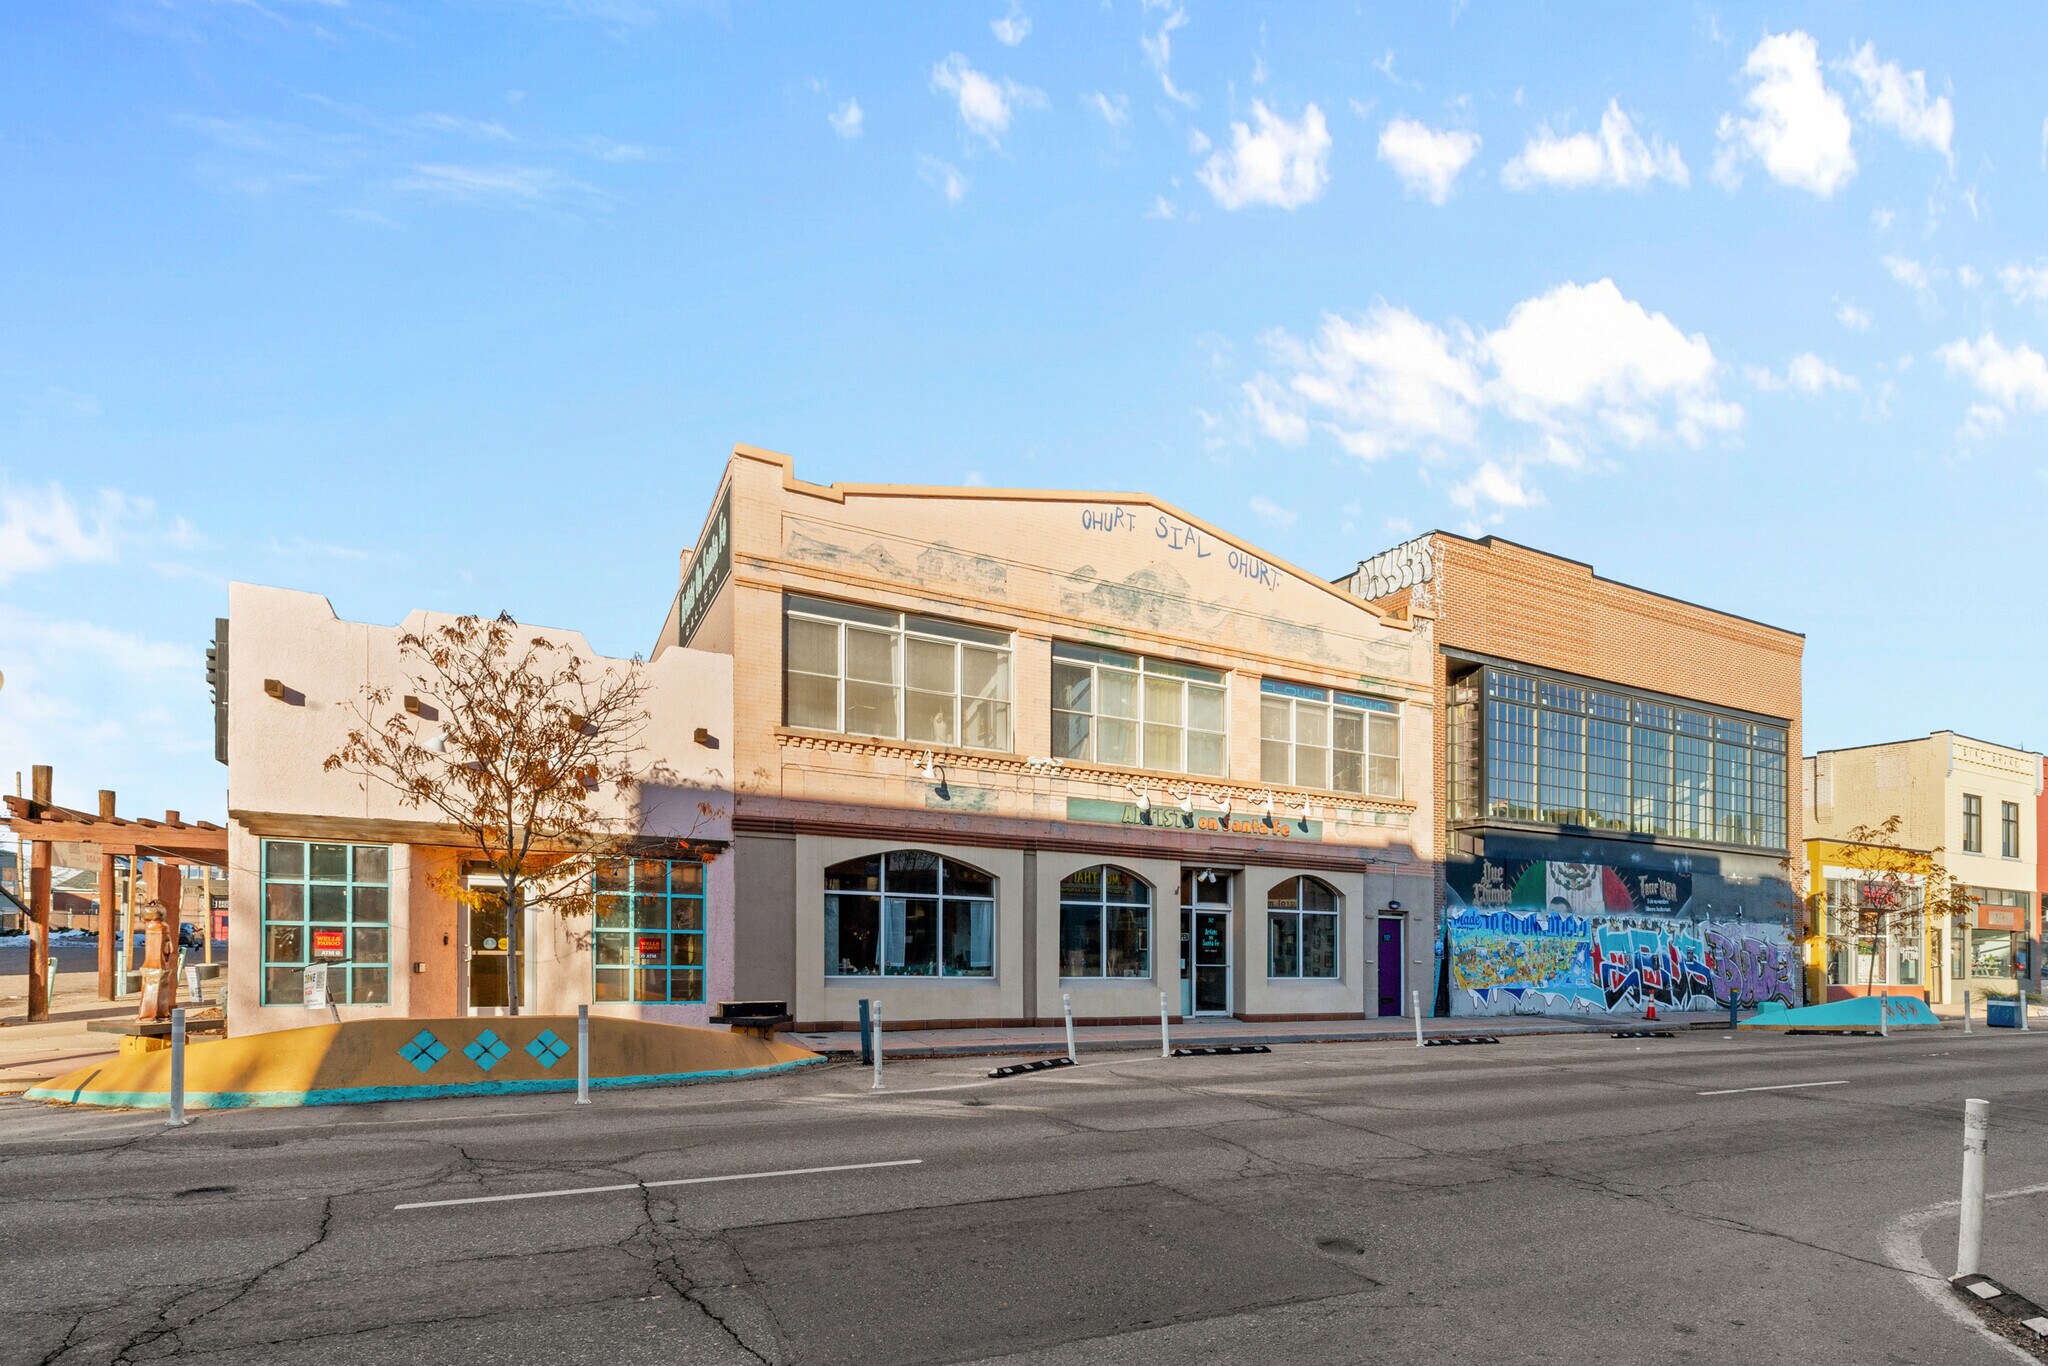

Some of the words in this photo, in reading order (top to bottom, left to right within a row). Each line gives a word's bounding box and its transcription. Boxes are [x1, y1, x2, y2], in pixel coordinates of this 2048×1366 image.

[1341, 696, 1389, 712] TOWN
[1198, 817, 1219, 831] on
[1272, 819, 1290, 836] Fe
